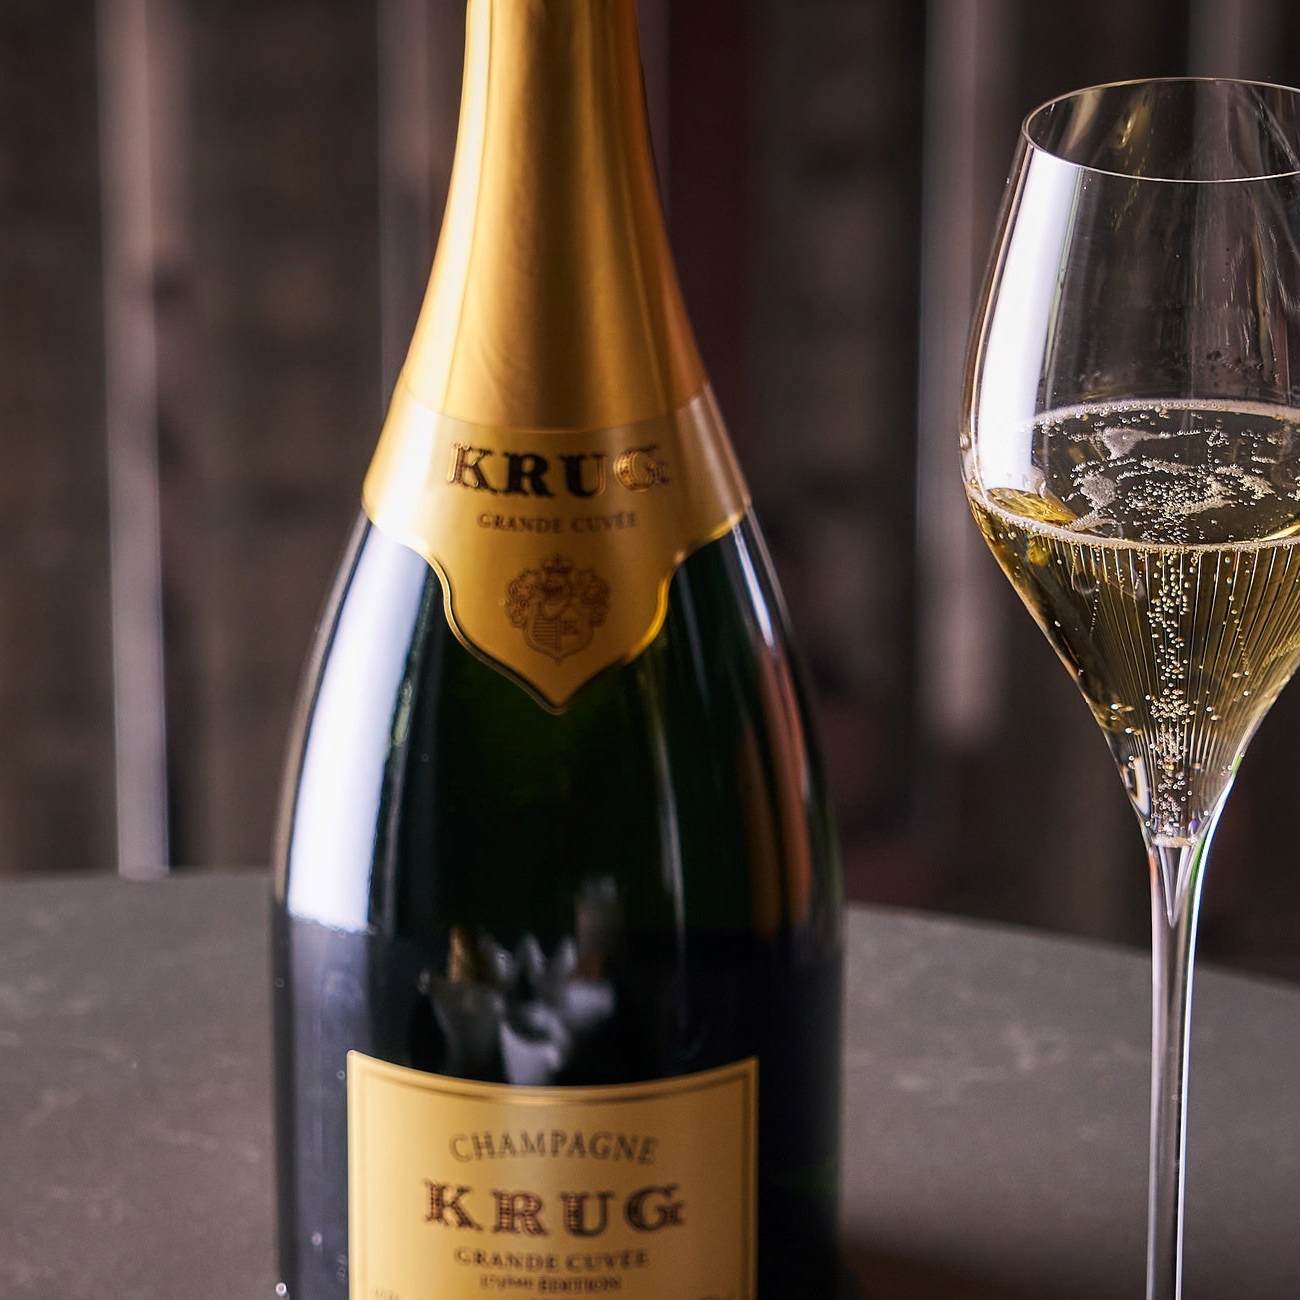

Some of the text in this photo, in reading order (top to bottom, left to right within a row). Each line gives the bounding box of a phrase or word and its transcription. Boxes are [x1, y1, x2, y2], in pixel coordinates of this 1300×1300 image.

[446, 441, 671, 499] KRUG
[477, 513, 565, 535] GRANDE
[449, 1129, 659, 1164] CHAMPAGNE
[423, 1178, 687, 1239] KRUG
[455, 1247, 558, 1272] GRANDE
